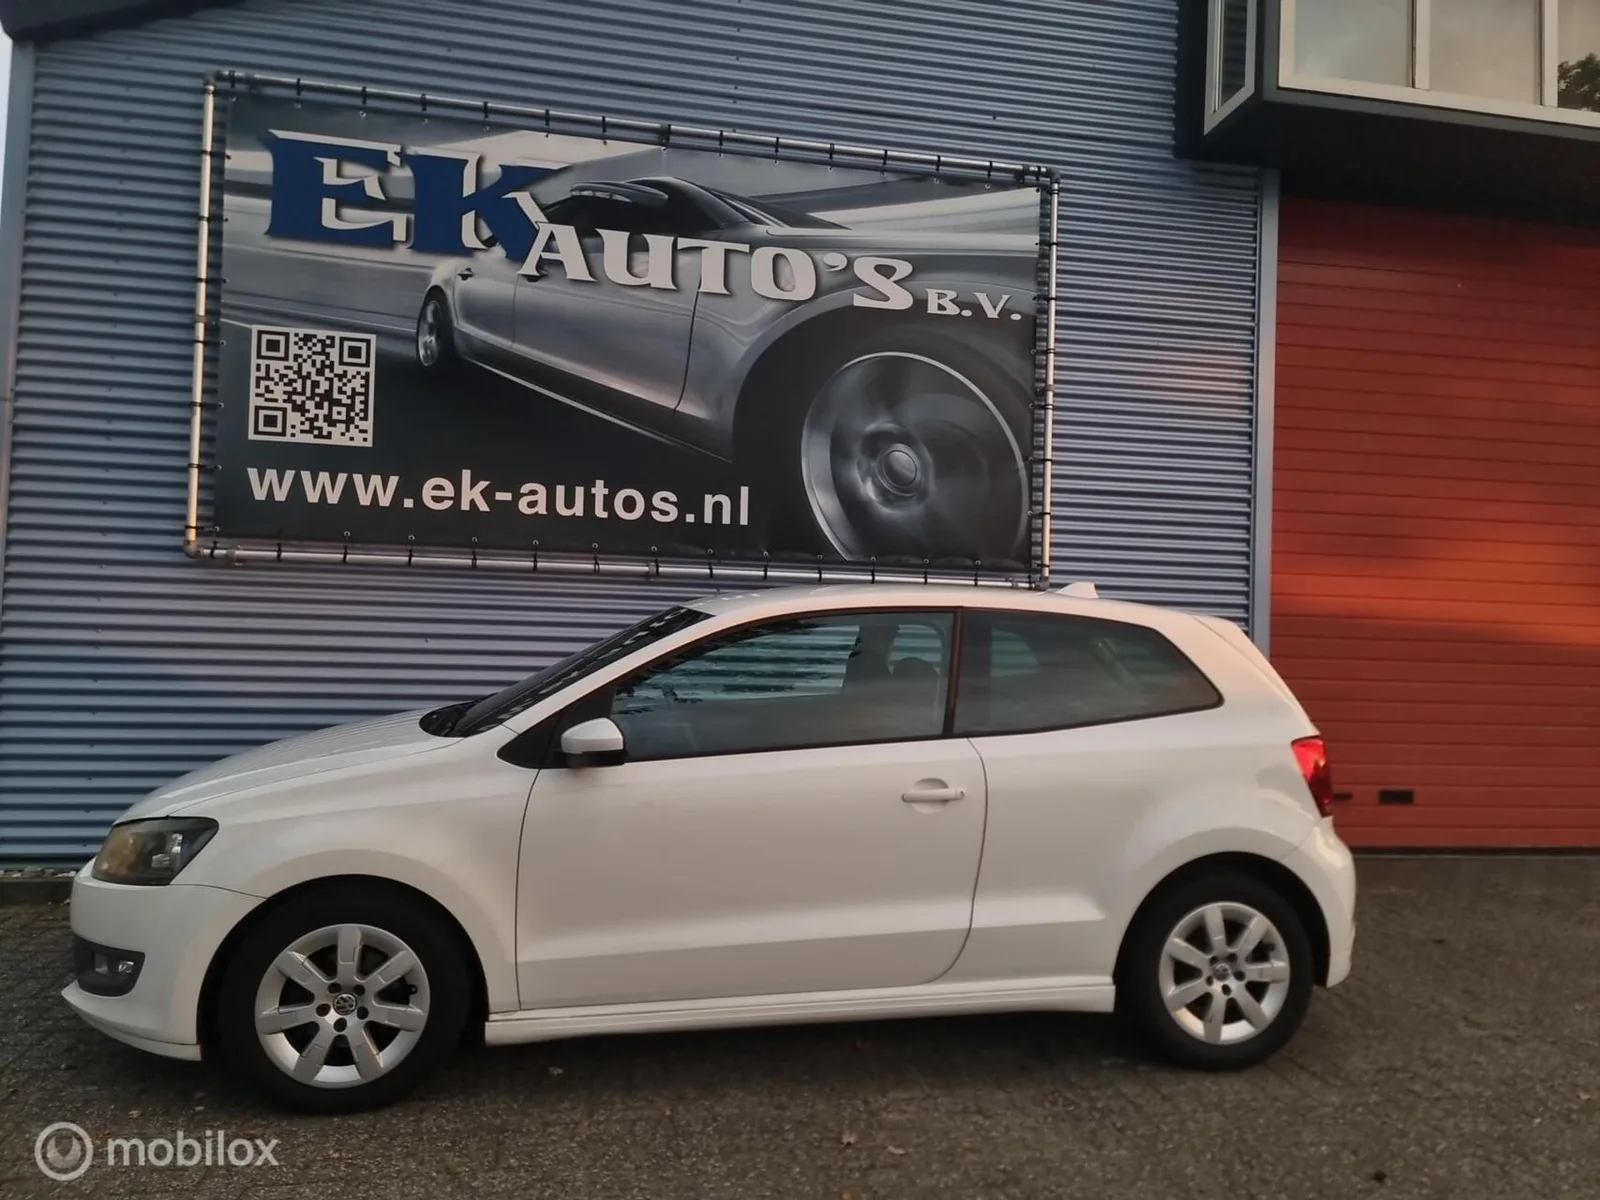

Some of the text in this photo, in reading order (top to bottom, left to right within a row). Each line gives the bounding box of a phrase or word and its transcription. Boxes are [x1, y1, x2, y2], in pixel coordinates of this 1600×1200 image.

[264, 130, 571, 262] EK
[925, 287, 1023, 321] B.V.
[247, 466, 750, 527] www.ek-autos.nl
